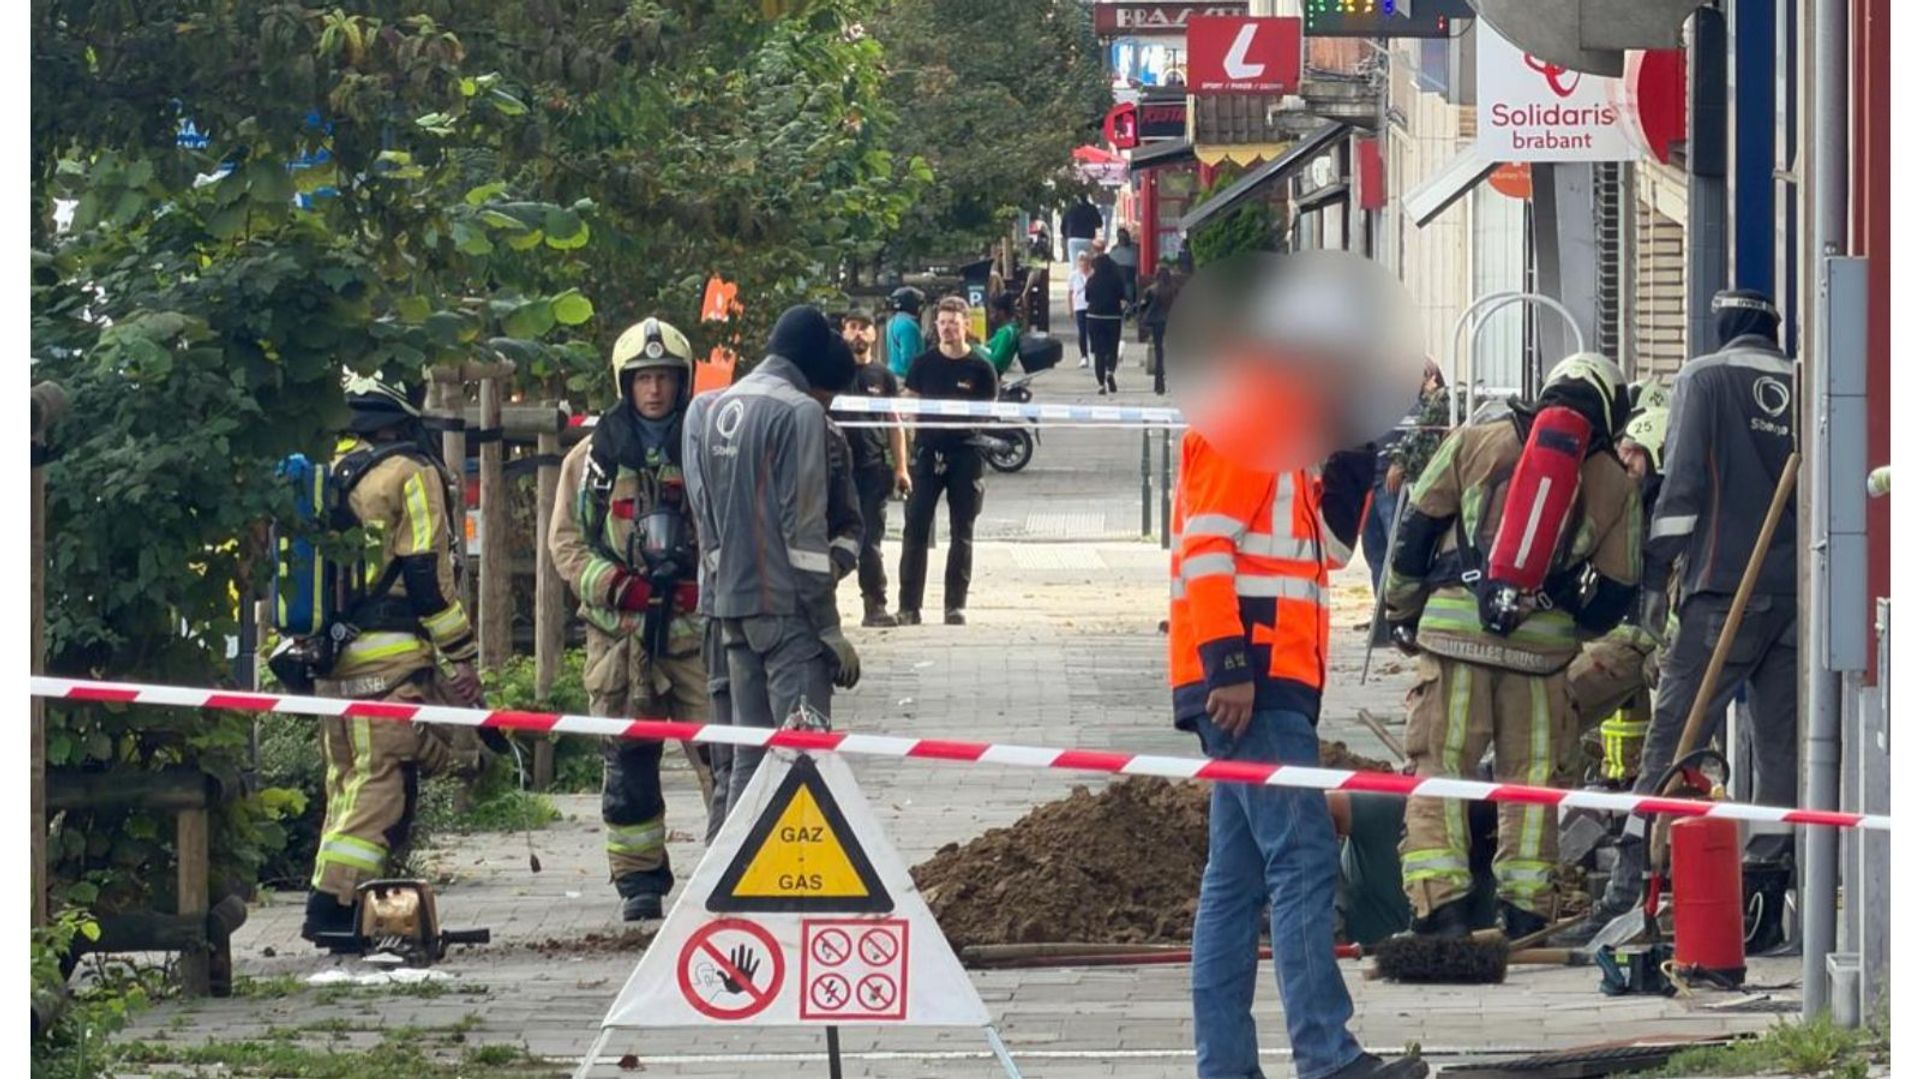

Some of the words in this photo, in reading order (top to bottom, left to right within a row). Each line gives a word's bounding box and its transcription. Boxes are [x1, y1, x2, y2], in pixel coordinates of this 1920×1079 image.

[1491, 103, 1616, 127] Solidaris
[1512, 130, 1593, 150] brabant
[1635, 420, 1652, 434] 25
[780, 826, 824, 844] GAZ
[778, 874, 823, 891] GAS
